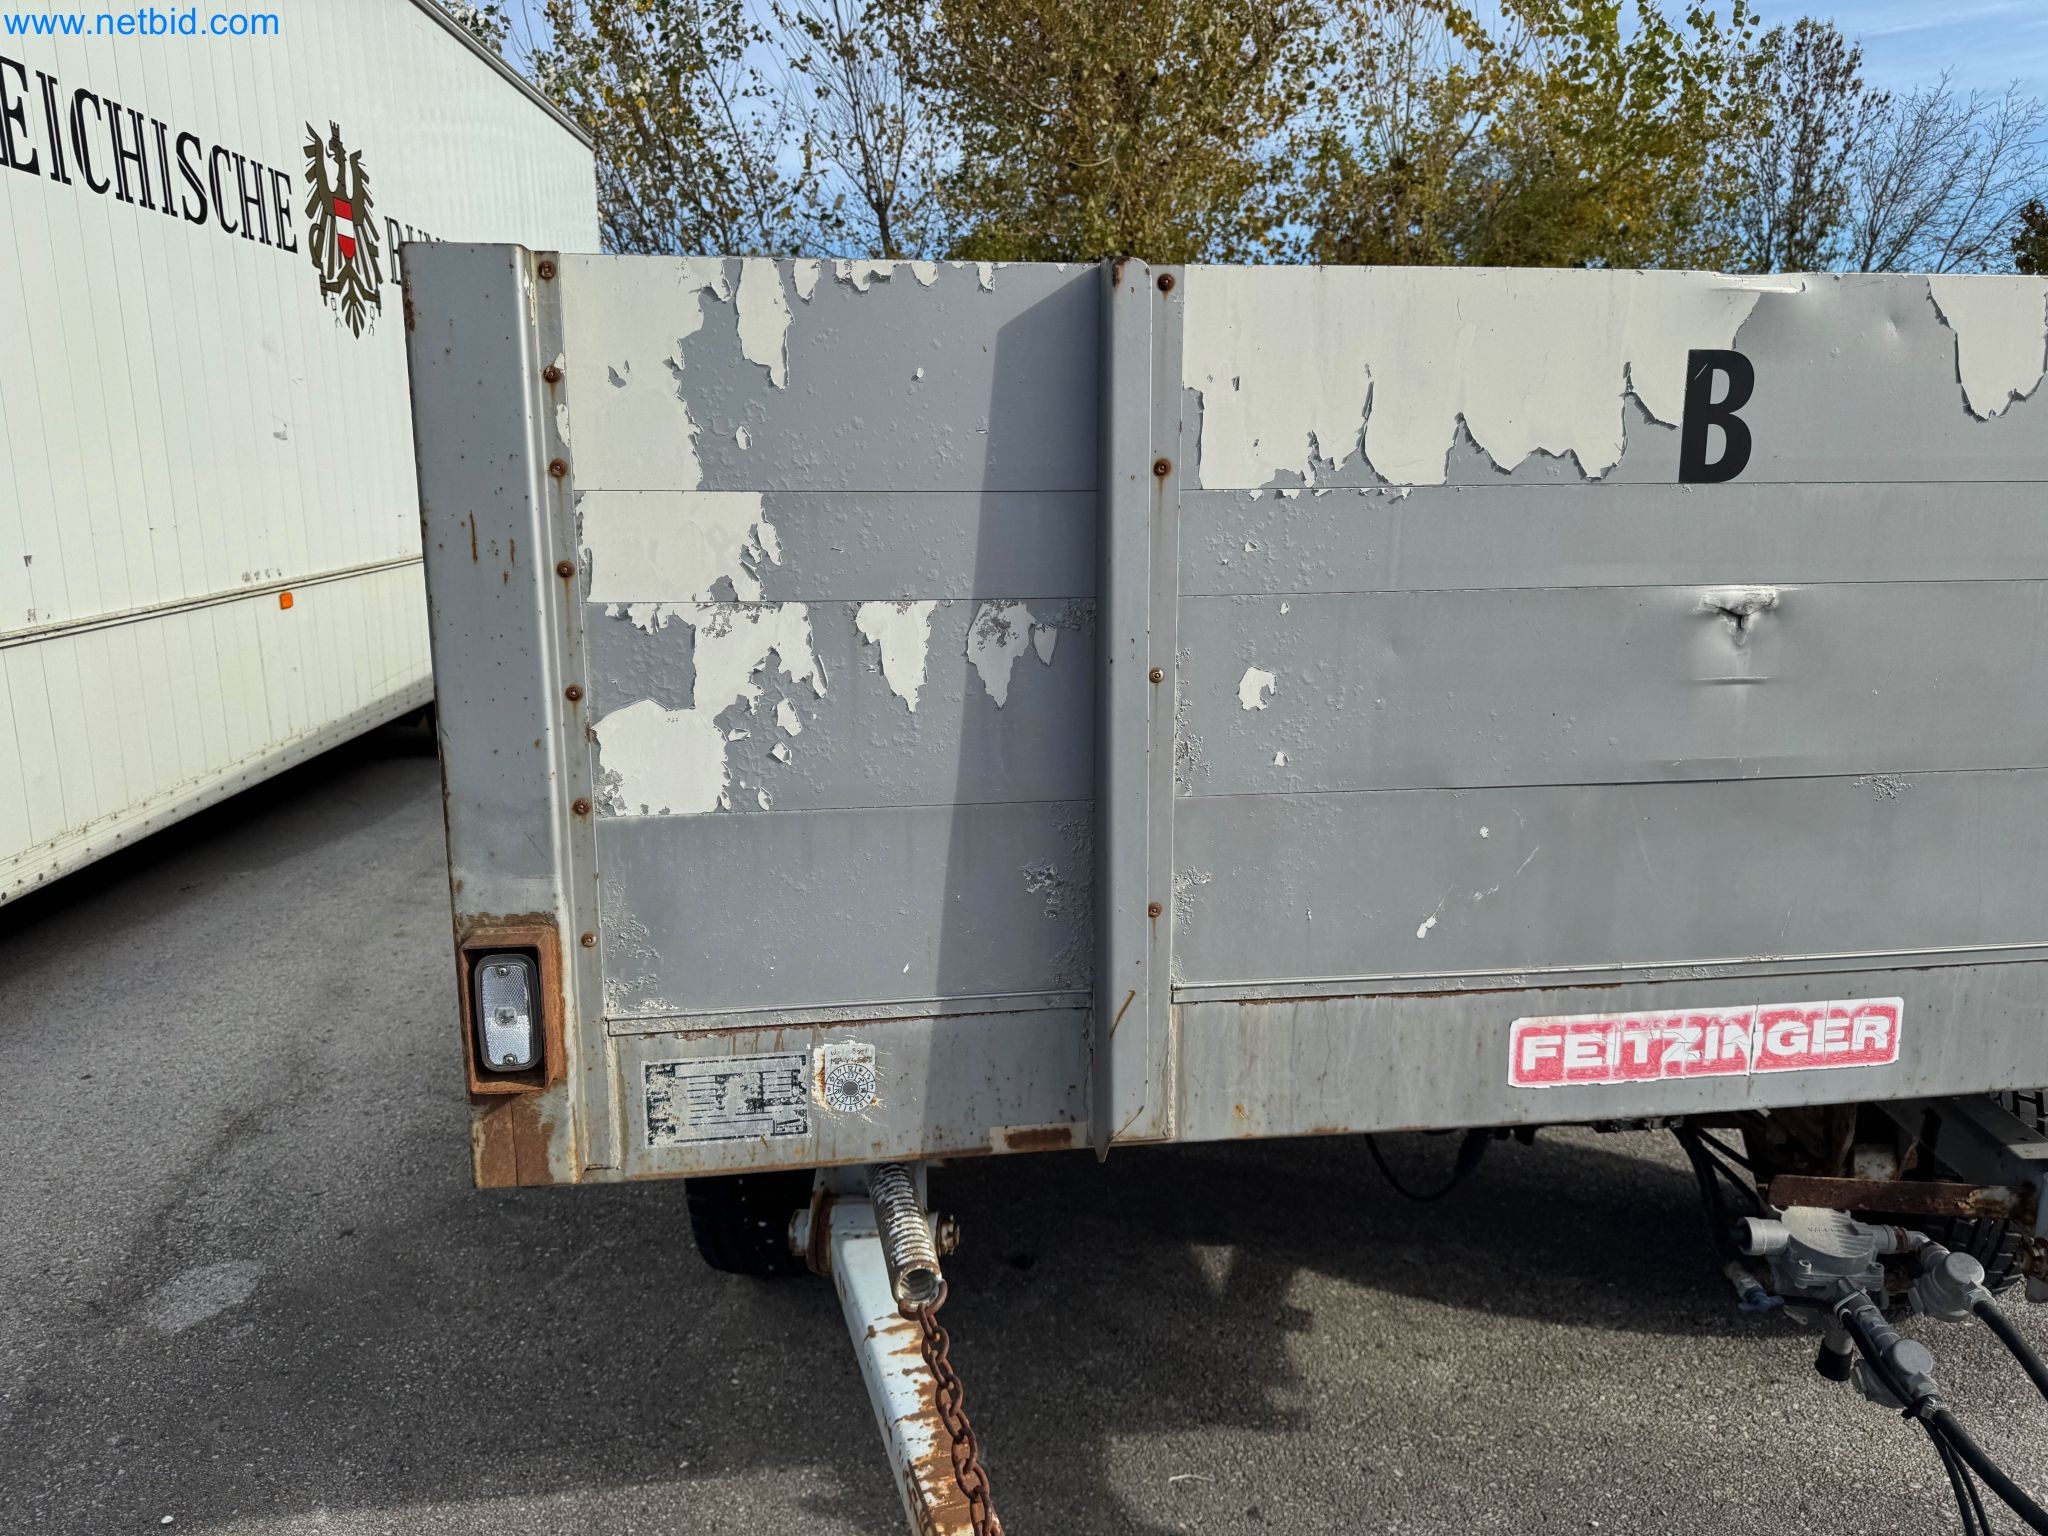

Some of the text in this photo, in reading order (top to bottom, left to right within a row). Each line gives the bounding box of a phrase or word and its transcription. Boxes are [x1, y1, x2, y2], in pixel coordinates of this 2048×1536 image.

[0, 56, 298, 253] EICHISCHE
[1678, 349, 1755, 483] B
[1522, 1015, 1891, 1070] FEITZINGER
